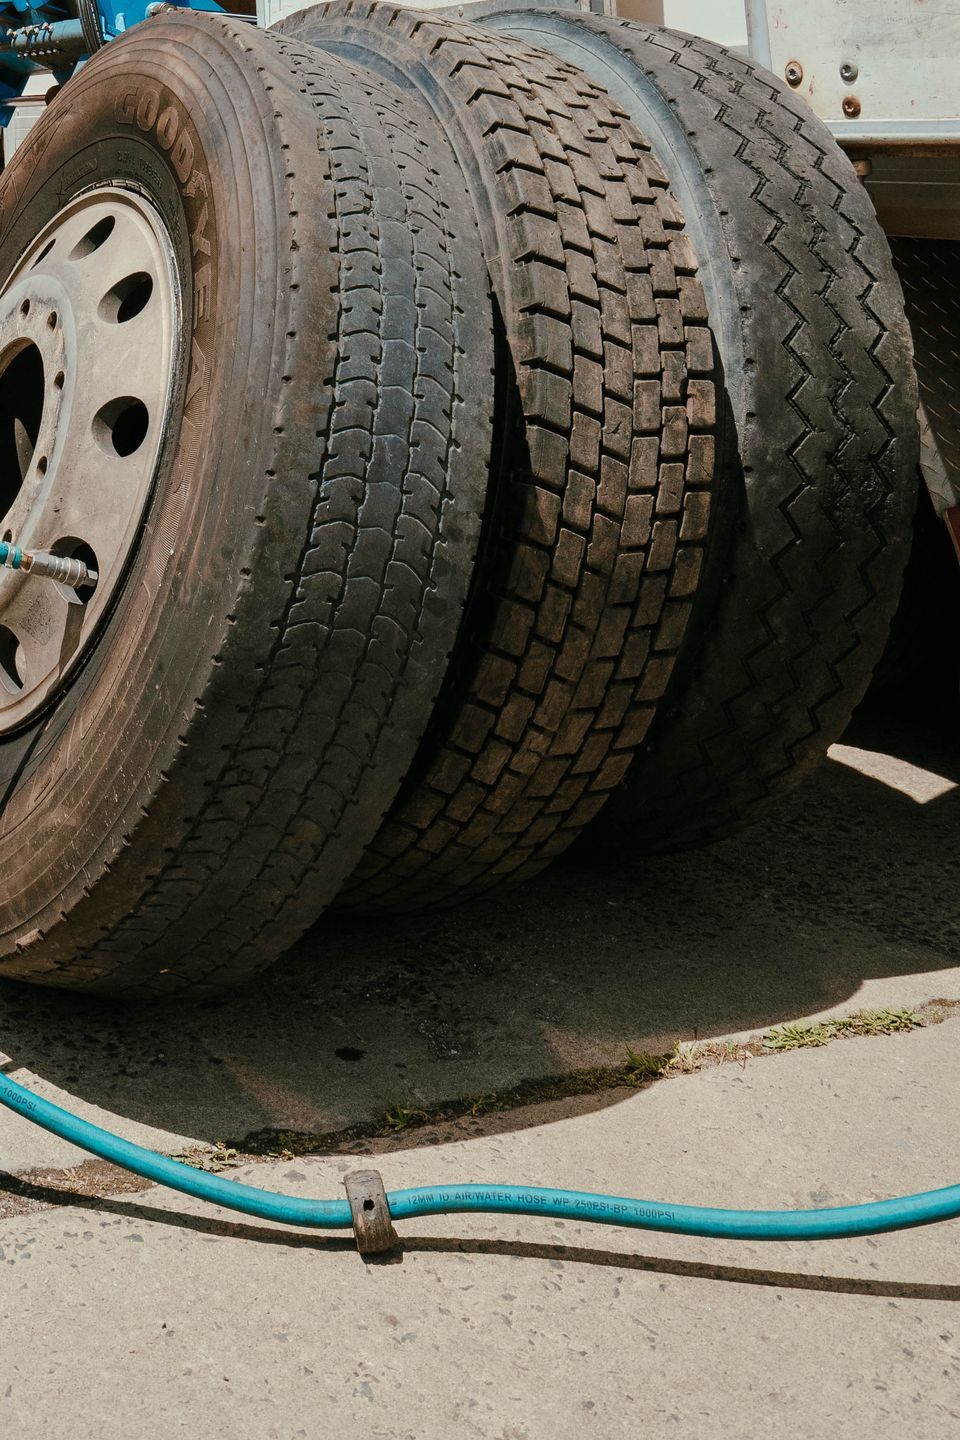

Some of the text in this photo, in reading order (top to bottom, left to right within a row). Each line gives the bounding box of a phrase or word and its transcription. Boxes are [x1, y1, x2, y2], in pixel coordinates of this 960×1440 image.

[3, 1087, 37, 1112] 1000PSI
[407, 1194, 435, 1206] 12MM
[454, 1191, 513, 1203] AIR/WATER
[517, 1194, 548, 1206] HOSE
[552, 1196, 570, 1208] WP
[634, 1207, 676, 1222] 1000PSI
